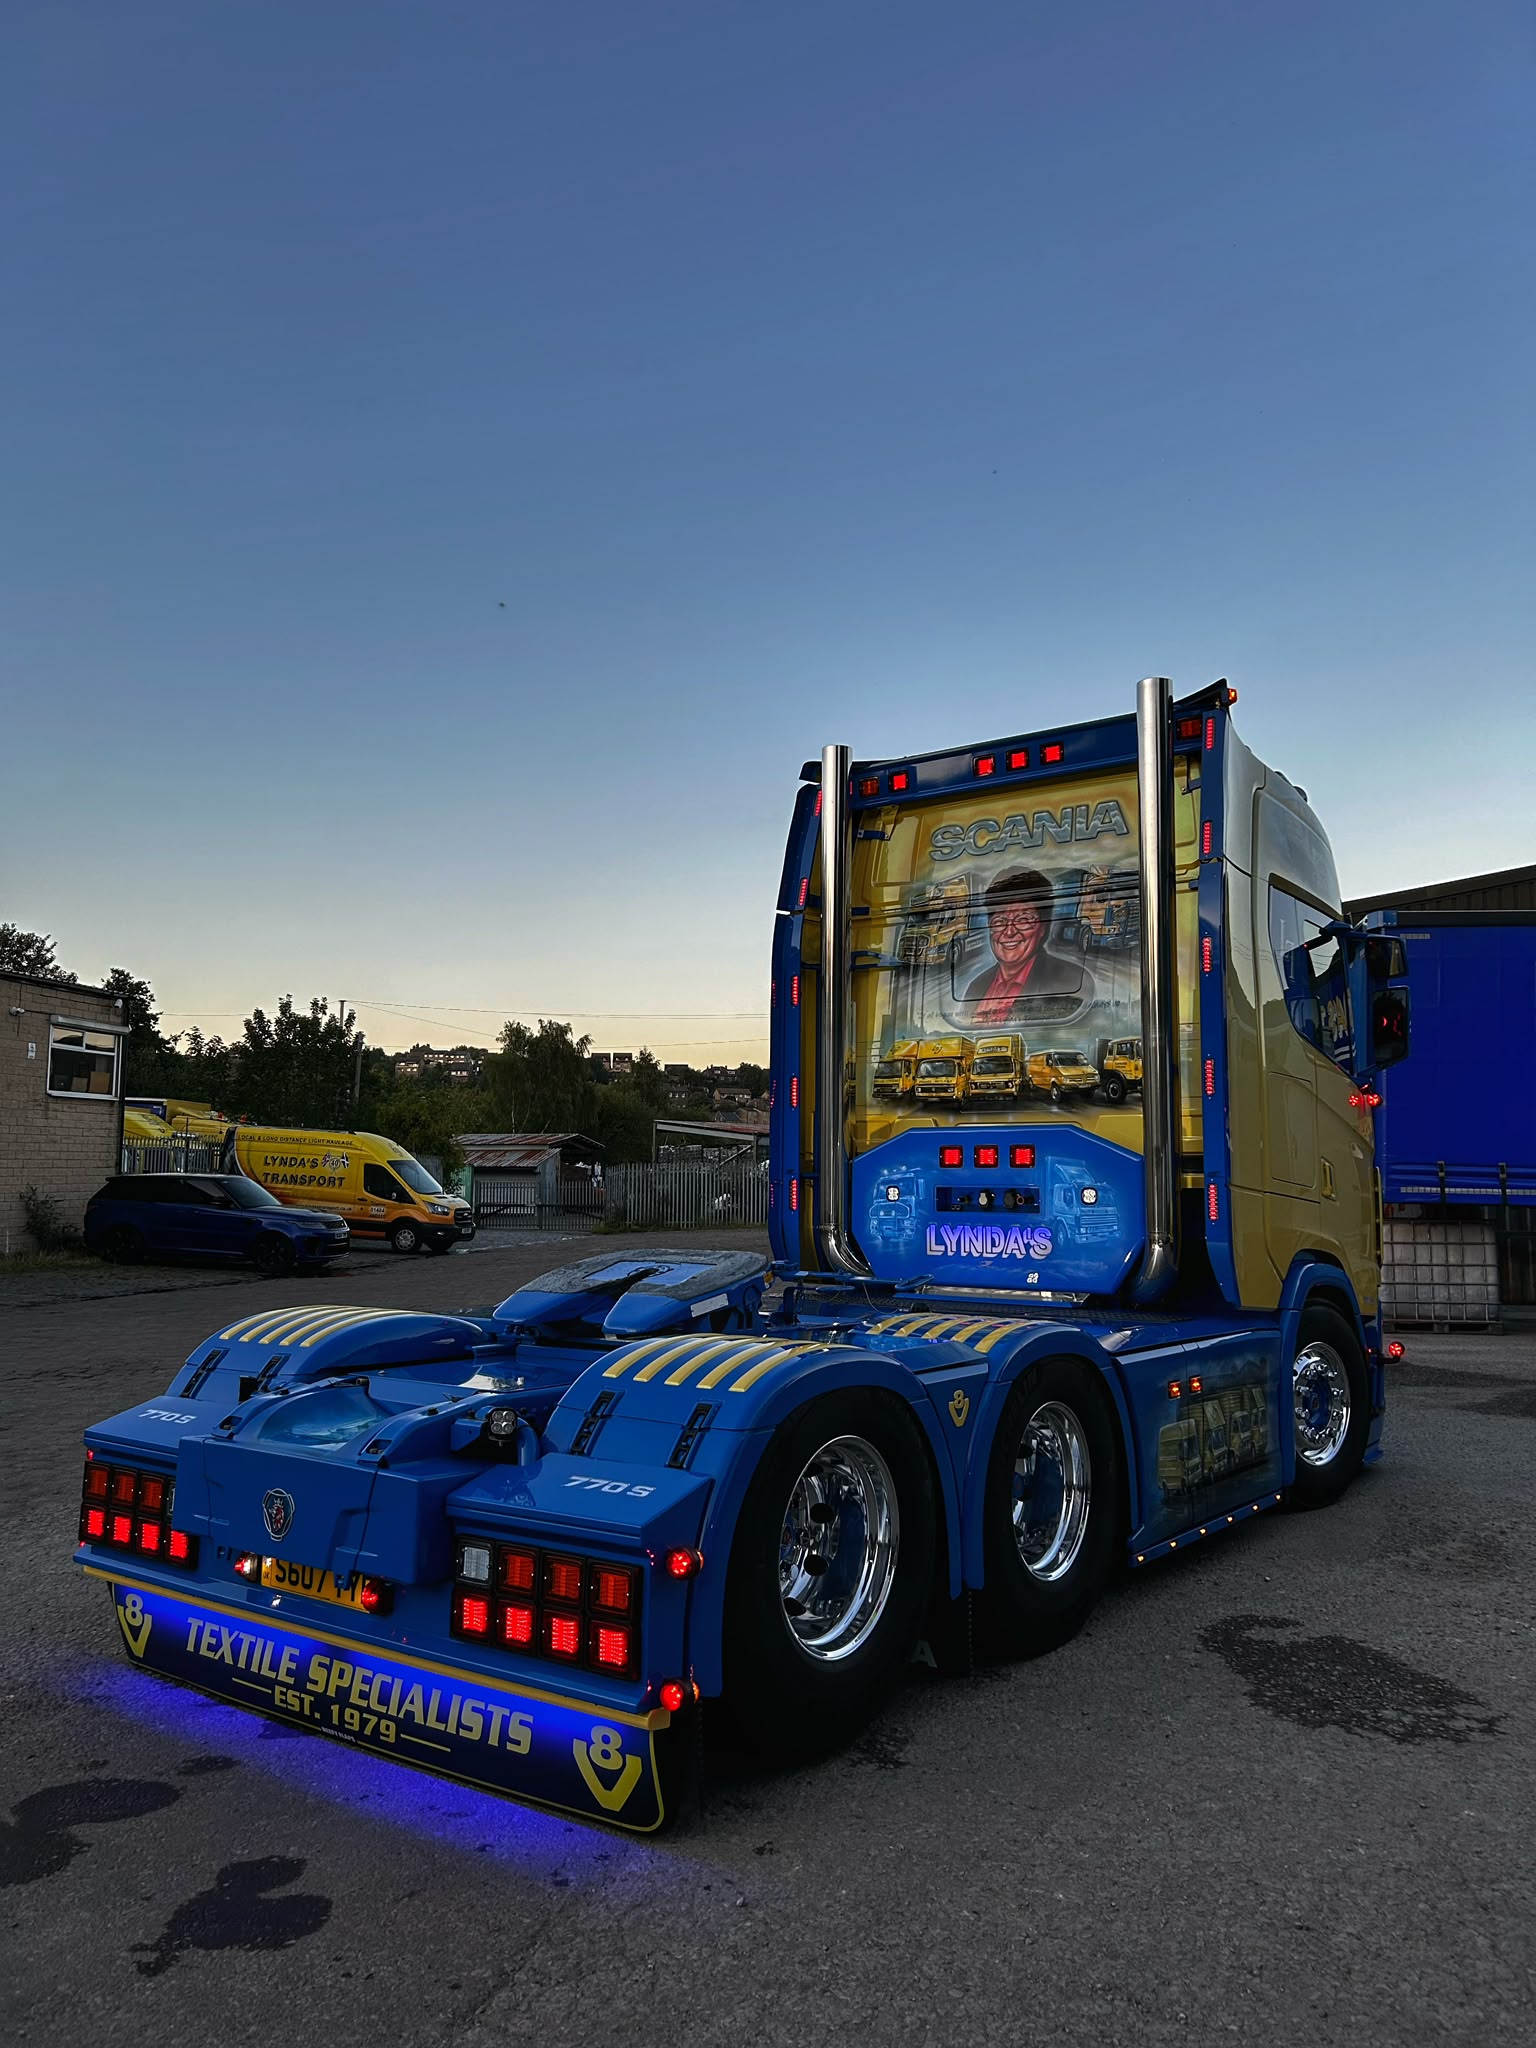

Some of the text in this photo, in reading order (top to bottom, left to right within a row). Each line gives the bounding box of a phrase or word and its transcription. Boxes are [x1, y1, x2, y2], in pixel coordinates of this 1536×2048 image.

[929, 799, 1130, 861] SCANIA
[280, 1136, 307, 1144] DISTANCE
[263, 1155, 319, 1169] LYNDA'S
[330, 1159, 339, 1167] 40
[262, 1172, 346, 1188] TRANSPORT
[926, 1223, 1053, 1260] LYNDA'S
[186, 1616, 534, 1755] TEXTILE SPECIALISTS
[274, 1685, 396, 1744] EST. 1979
